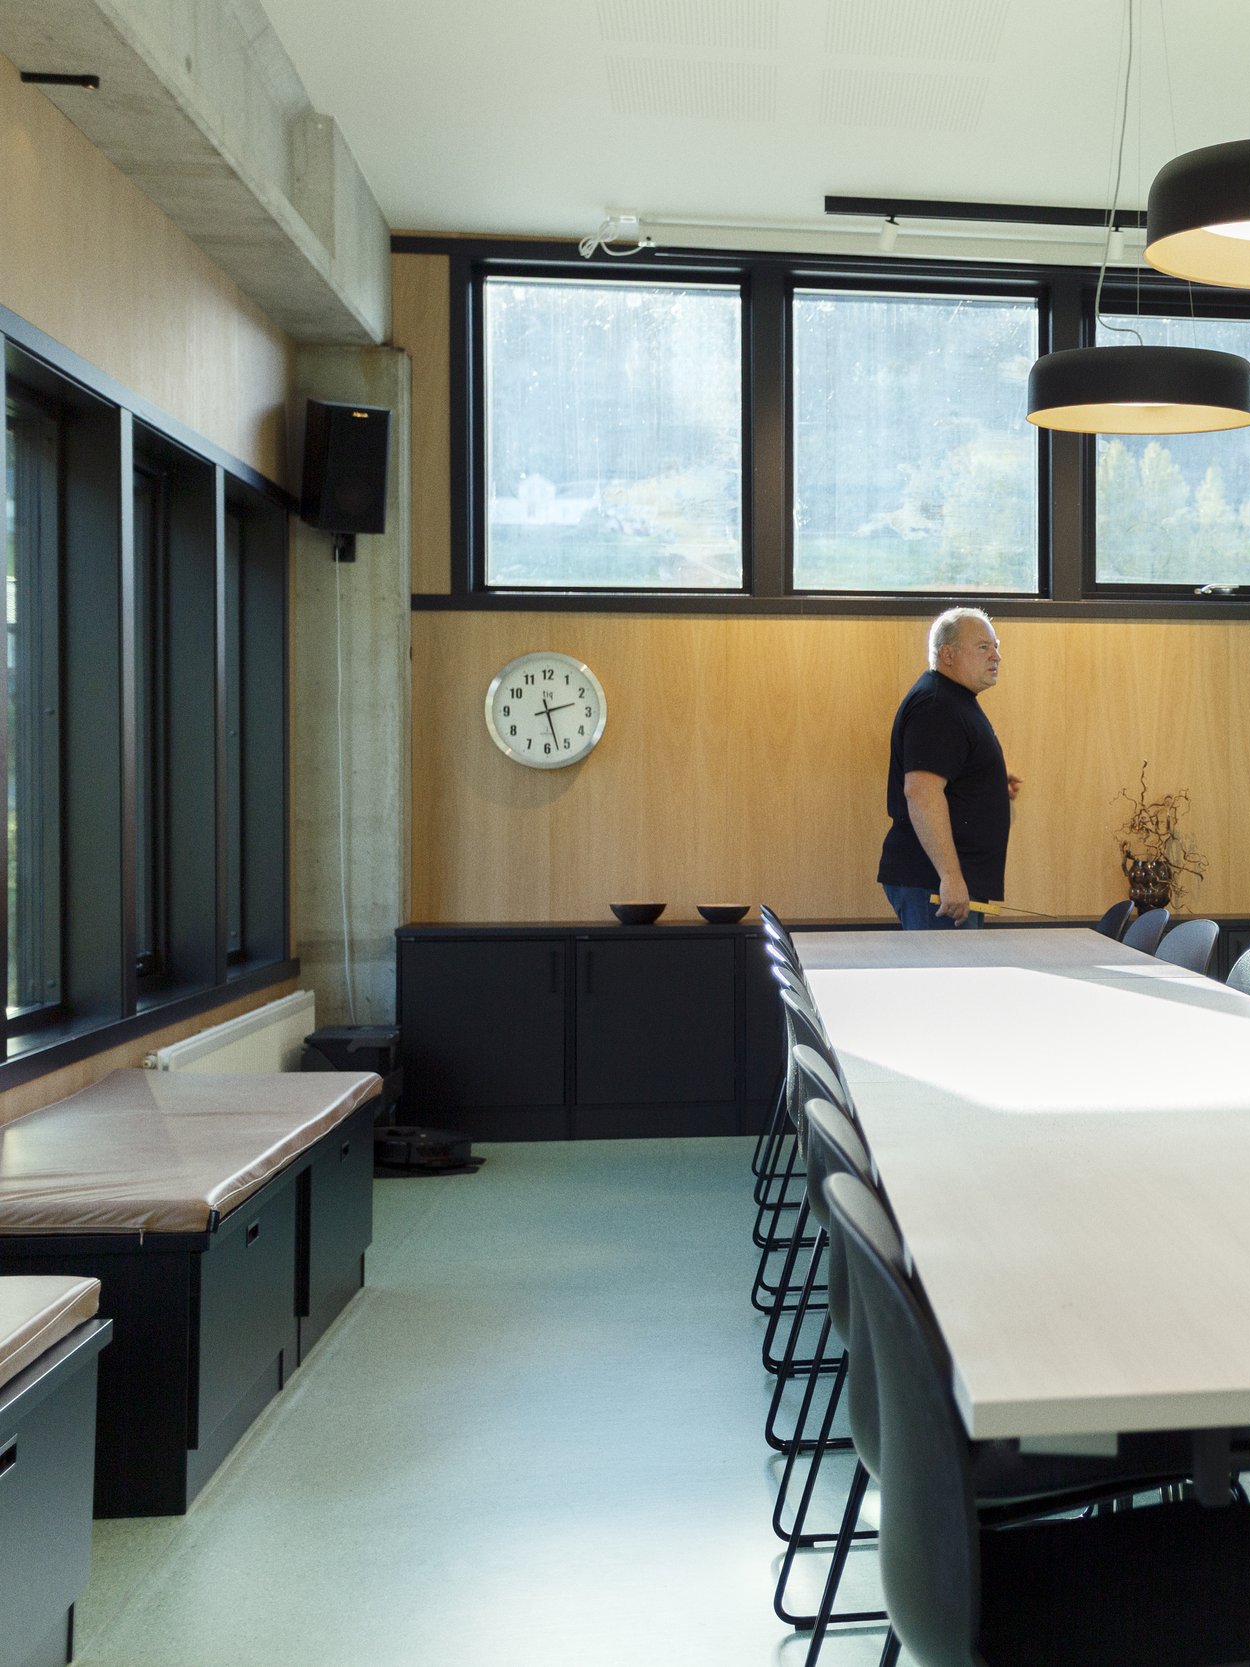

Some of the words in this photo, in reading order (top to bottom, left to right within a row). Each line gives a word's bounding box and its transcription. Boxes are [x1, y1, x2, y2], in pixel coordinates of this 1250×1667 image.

[524, 674, 535, 685] 11
[541, 669, 554, 681] 12
[564, 674, 570, 685] 1
[509, 687, 523, 699] 10
[578, 687, 585, 699] 2
[503, 705, 510, 717] 9
[585, 706, 592, 718] 3
[510, 725, 517, 736] 8
[577, 725, 585, 736] 4
[526, 738, 532, 750] 7
[543, 743, 551, 755] 6
[563, 738, 571, 749] 5
